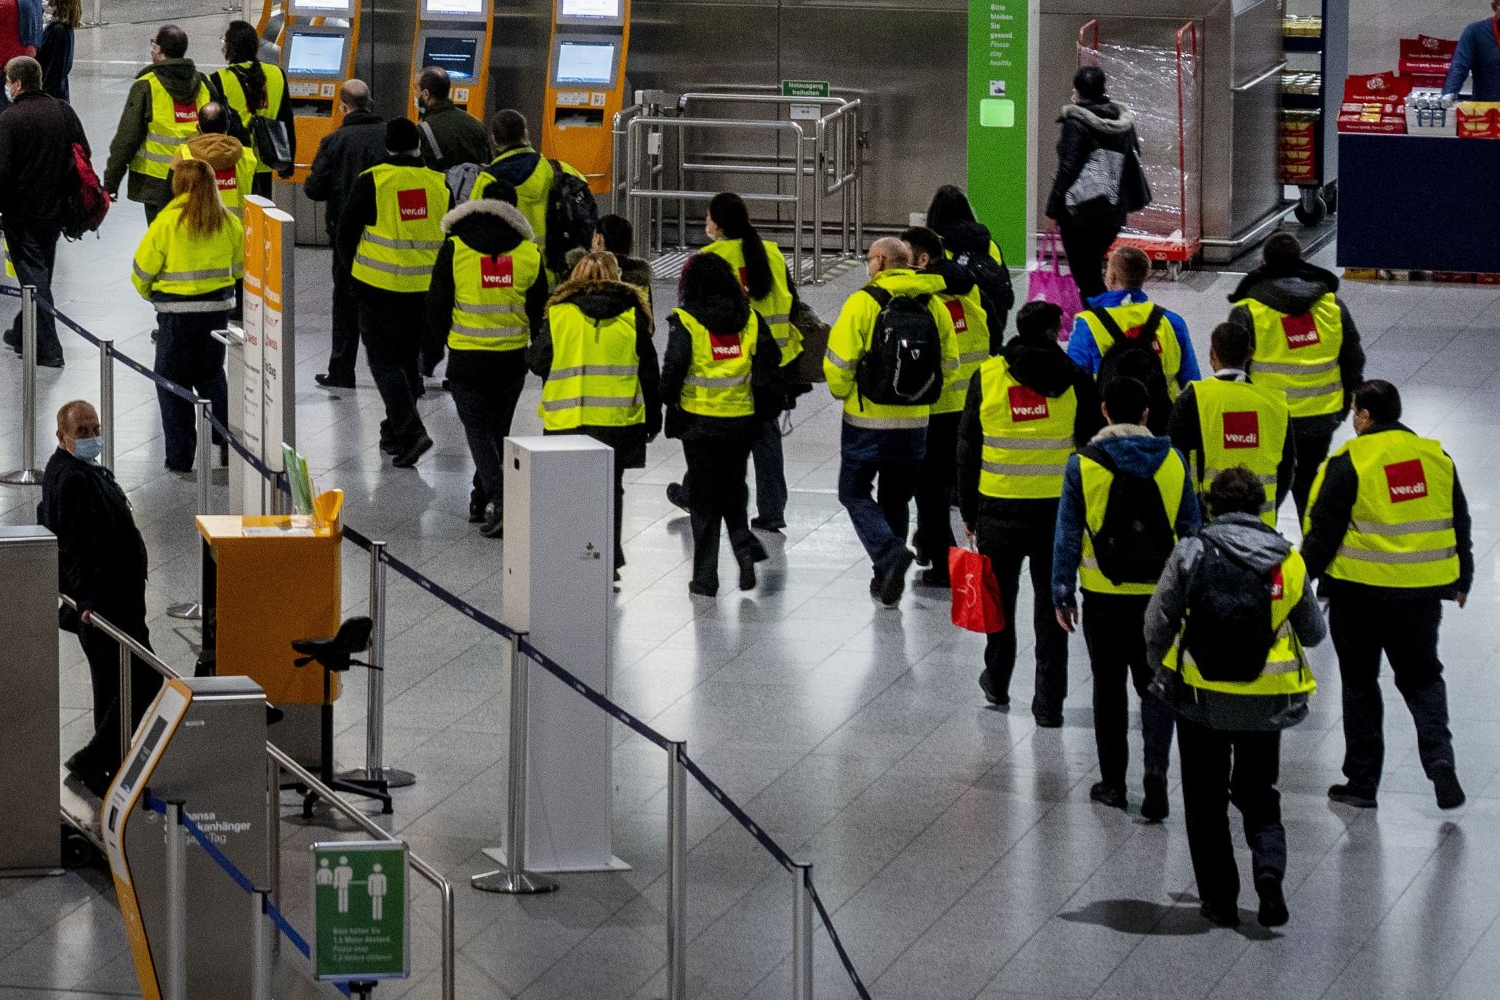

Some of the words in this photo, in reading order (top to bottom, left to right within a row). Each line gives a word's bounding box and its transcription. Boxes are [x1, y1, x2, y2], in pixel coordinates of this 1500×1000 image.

[789, 82, 823, 90] Notausgang
[401, 207, 426, 216] ver.di
[483, 275, 512, 284] ver.di
[1288, 330, 1318, 343] ver.di
[713, 345, 740, 355] ver.di
[1012, 404, 1046, 416] ver.di
[1225, 432, 1257, 444] ver.di
[1391, 483, 1425, 495] ver.di
[210, 833, 226, 844] Tag
